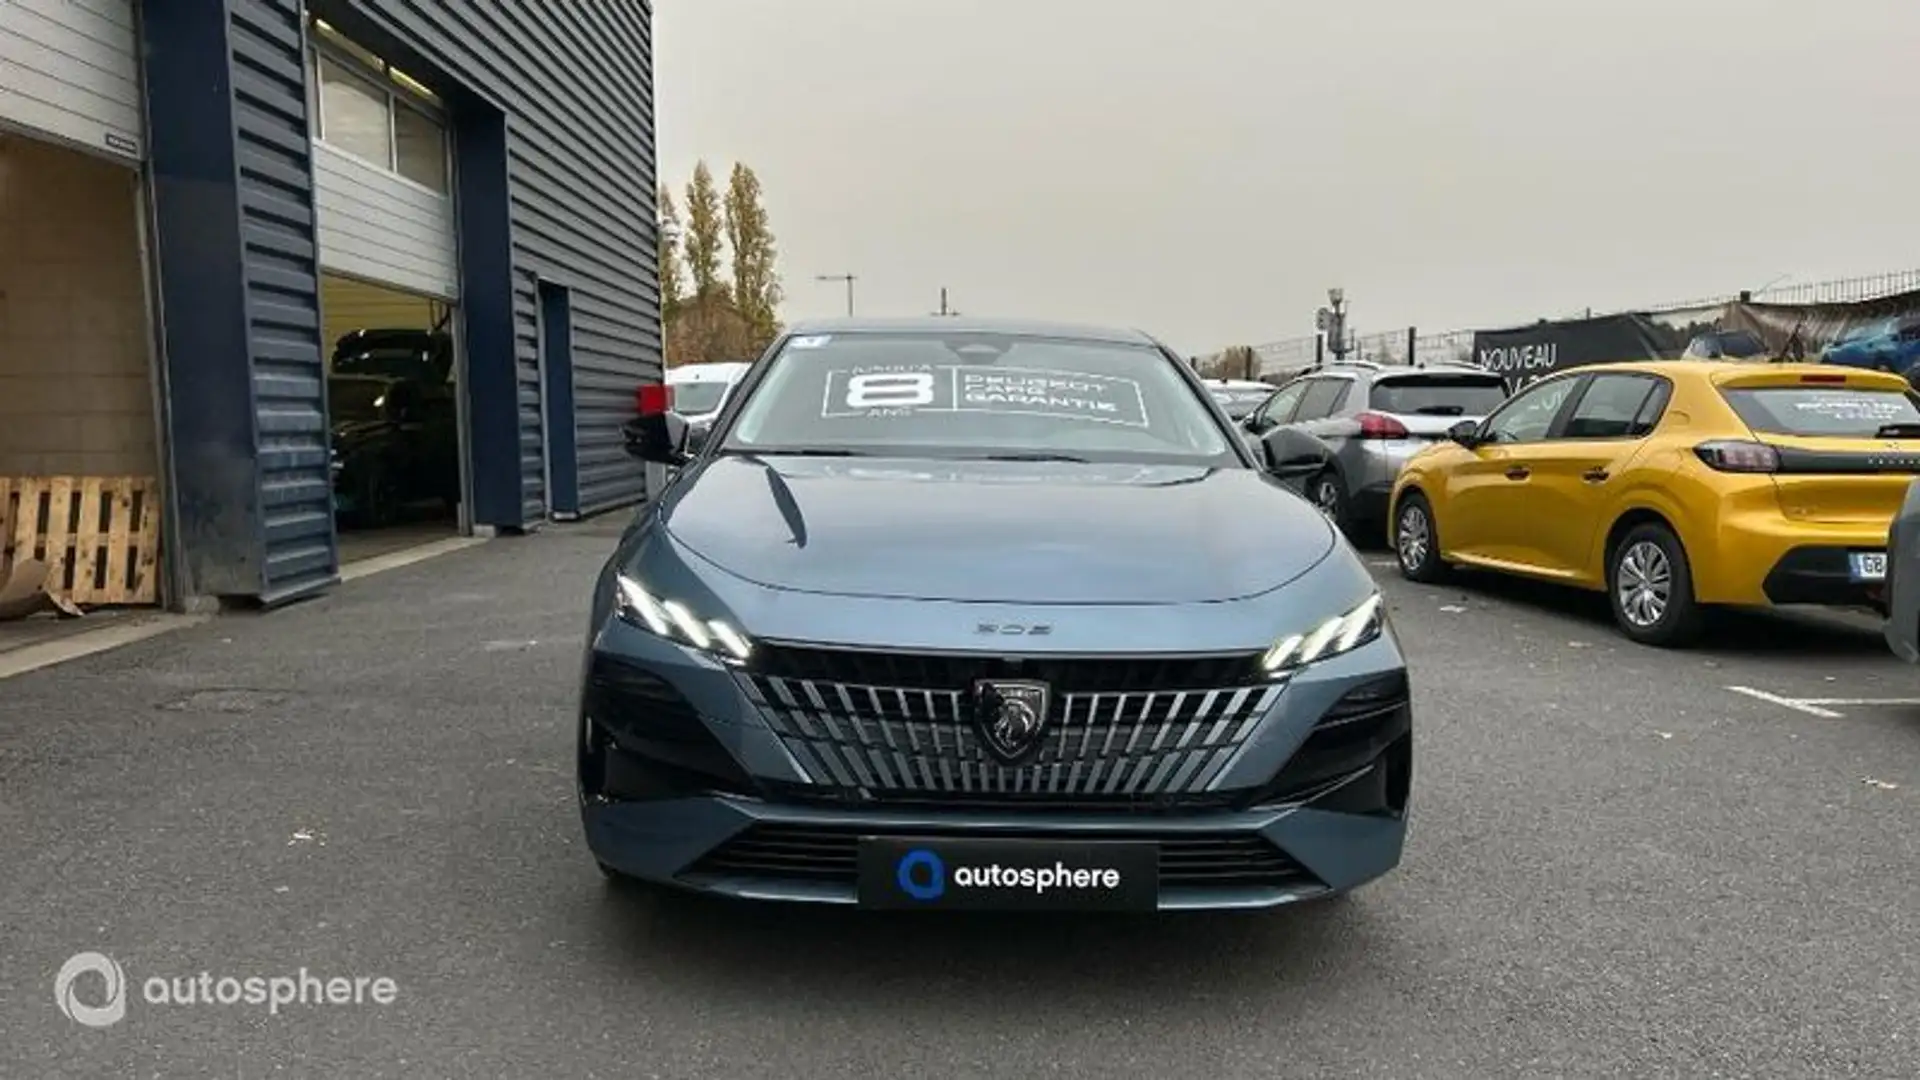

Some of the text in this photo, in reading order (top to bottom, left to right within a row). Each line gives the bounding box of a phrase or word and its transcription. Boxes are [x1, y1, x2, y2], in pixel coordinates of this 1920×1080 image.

[1480, 343, 1557, 372] NOUVEAU
[846, 373, 934, 407] 8
[954, 861, 1120, 894] autosphere
